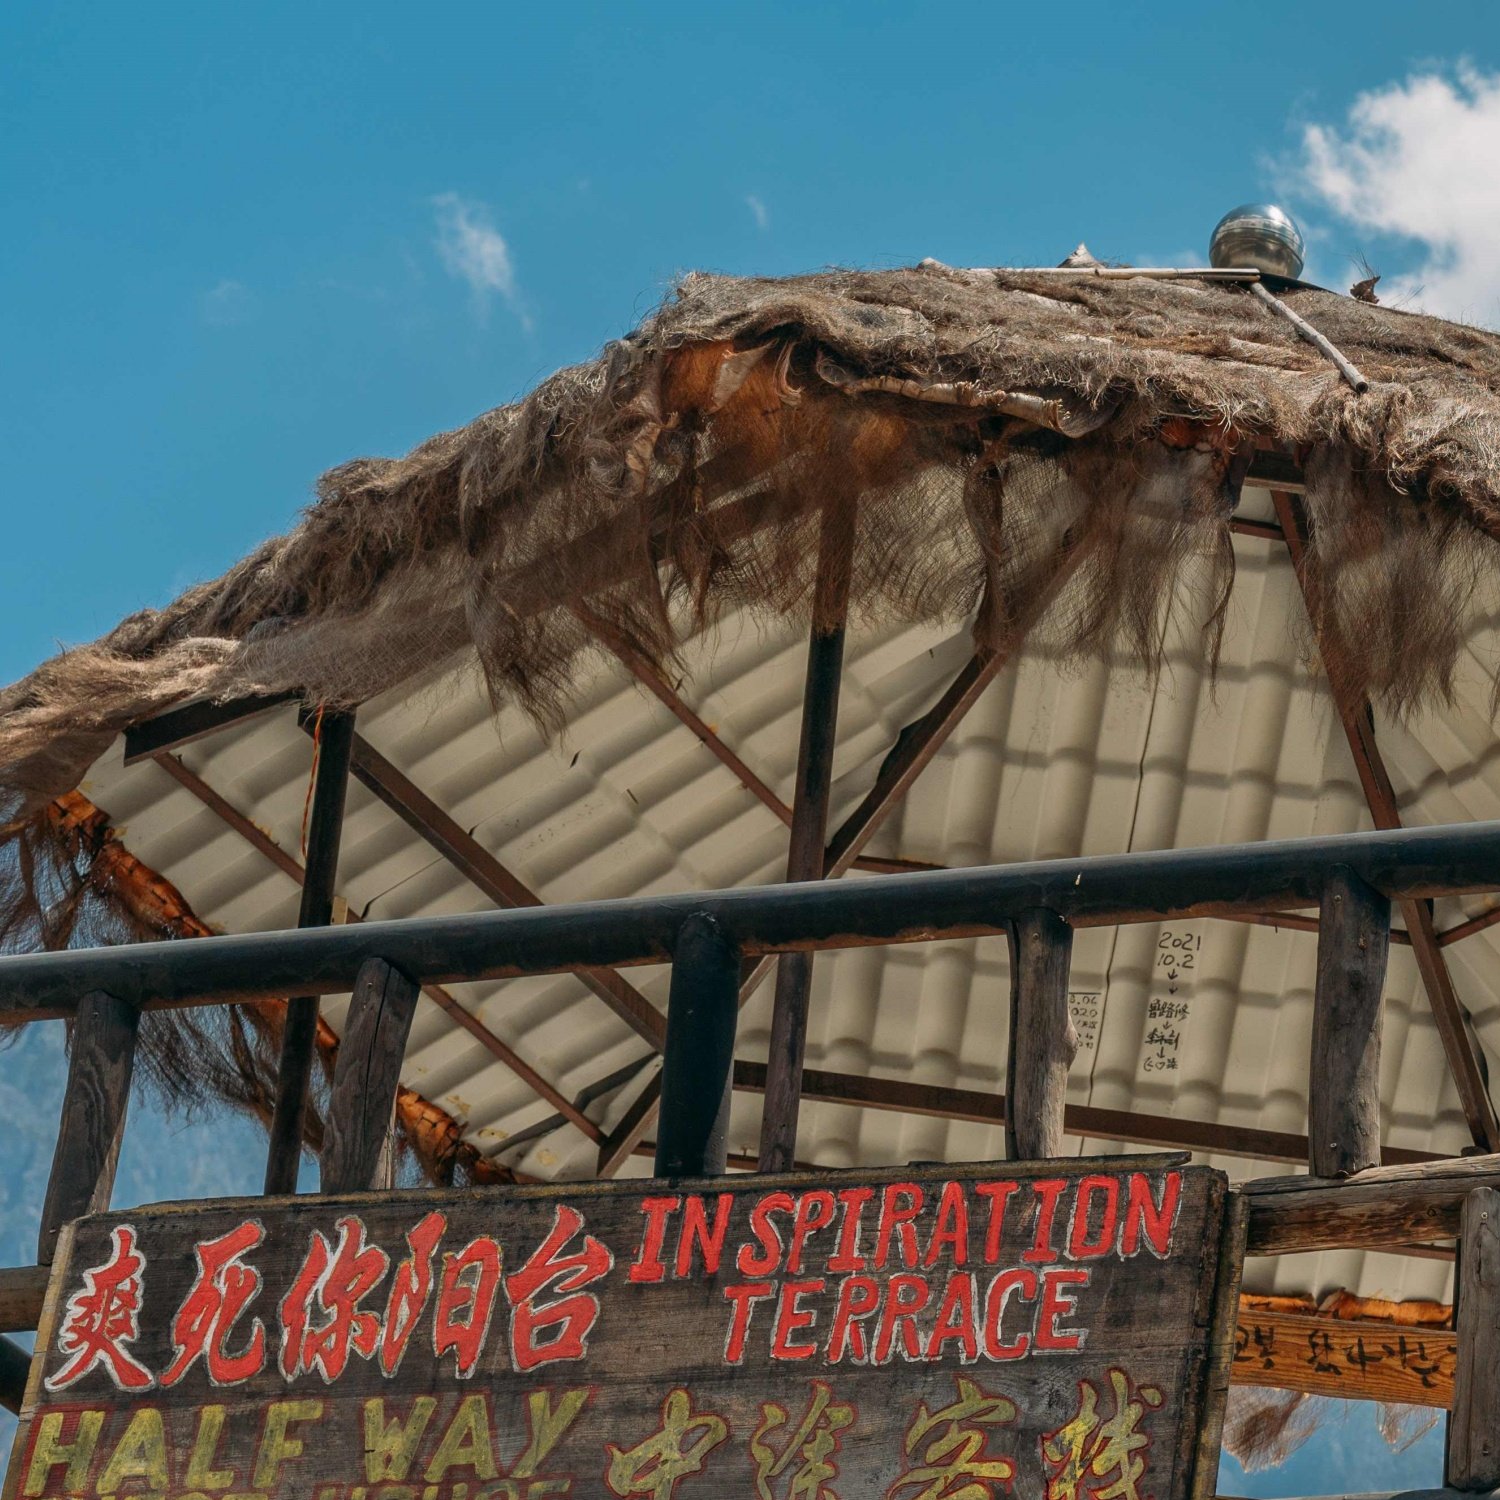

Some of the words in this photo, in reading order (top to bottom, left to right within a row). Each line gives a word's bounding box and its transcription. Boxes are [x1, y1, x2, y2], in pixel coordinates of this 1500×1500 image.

[1157, 953, 1195, 969] 10.2
[1158, 931, 1201, 951] 2021
[627, 1171, 1184, 1285] INSPIRATION
[43, 1203, 614, 1392] 爽死你阳台
[722, 1265, 1093, 1367] TERRACE
[22, 1399, 324, 1498] HALF
[364, 1388, 590, 1483] WAY
